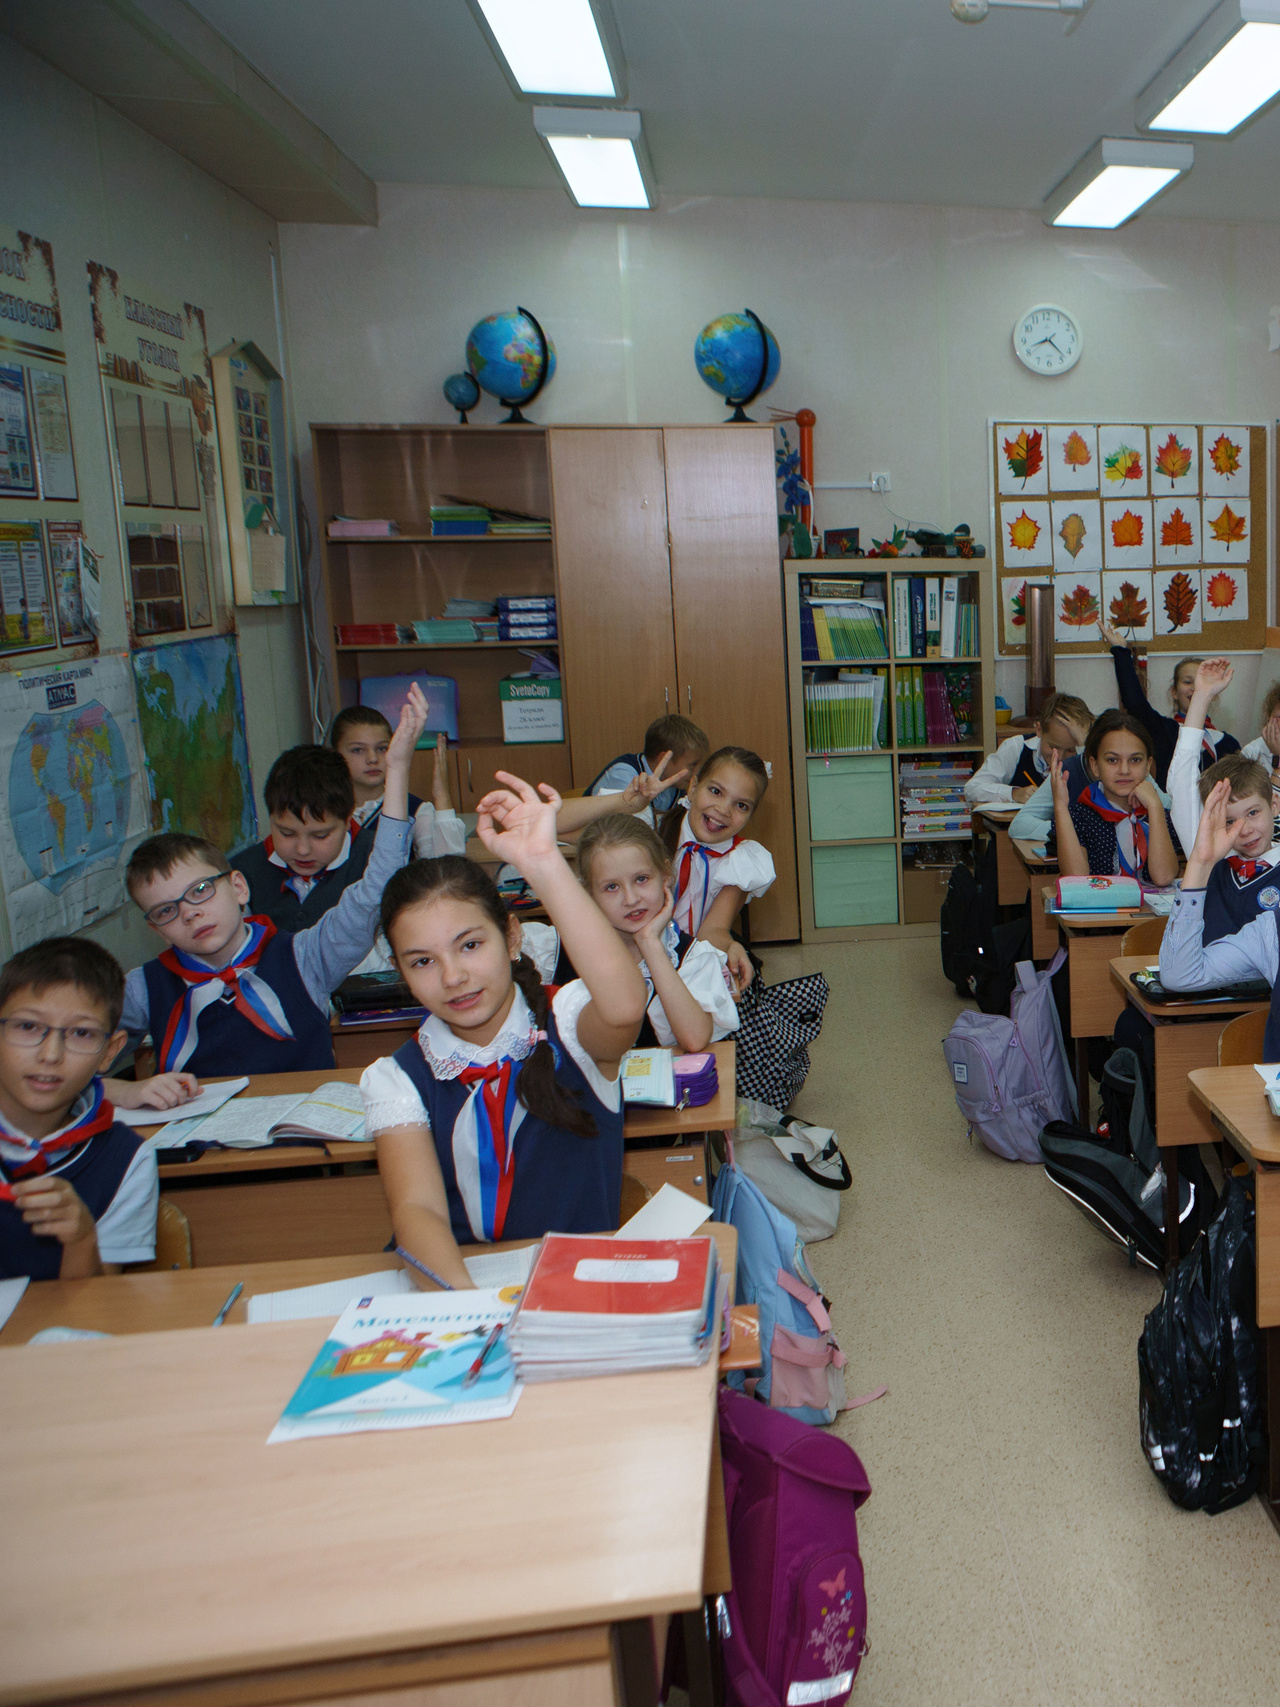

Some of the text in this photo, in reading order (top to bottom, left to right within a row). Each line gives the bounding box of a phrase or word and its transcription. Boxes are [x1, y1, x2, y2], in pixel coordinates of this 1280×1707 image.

[124, 295, 184, 340] КЛАССНЫЙ
[1032, 316, 1039, 324] 11
[1042, 312, 1050, 321] 12
[1025, 325, 1033, 333] 10
[137, 336, 180, 373] УГОЛОК
[509, 683, 550, 698] SvetoCopy
[352, 1310, 512, 1330] Математика
